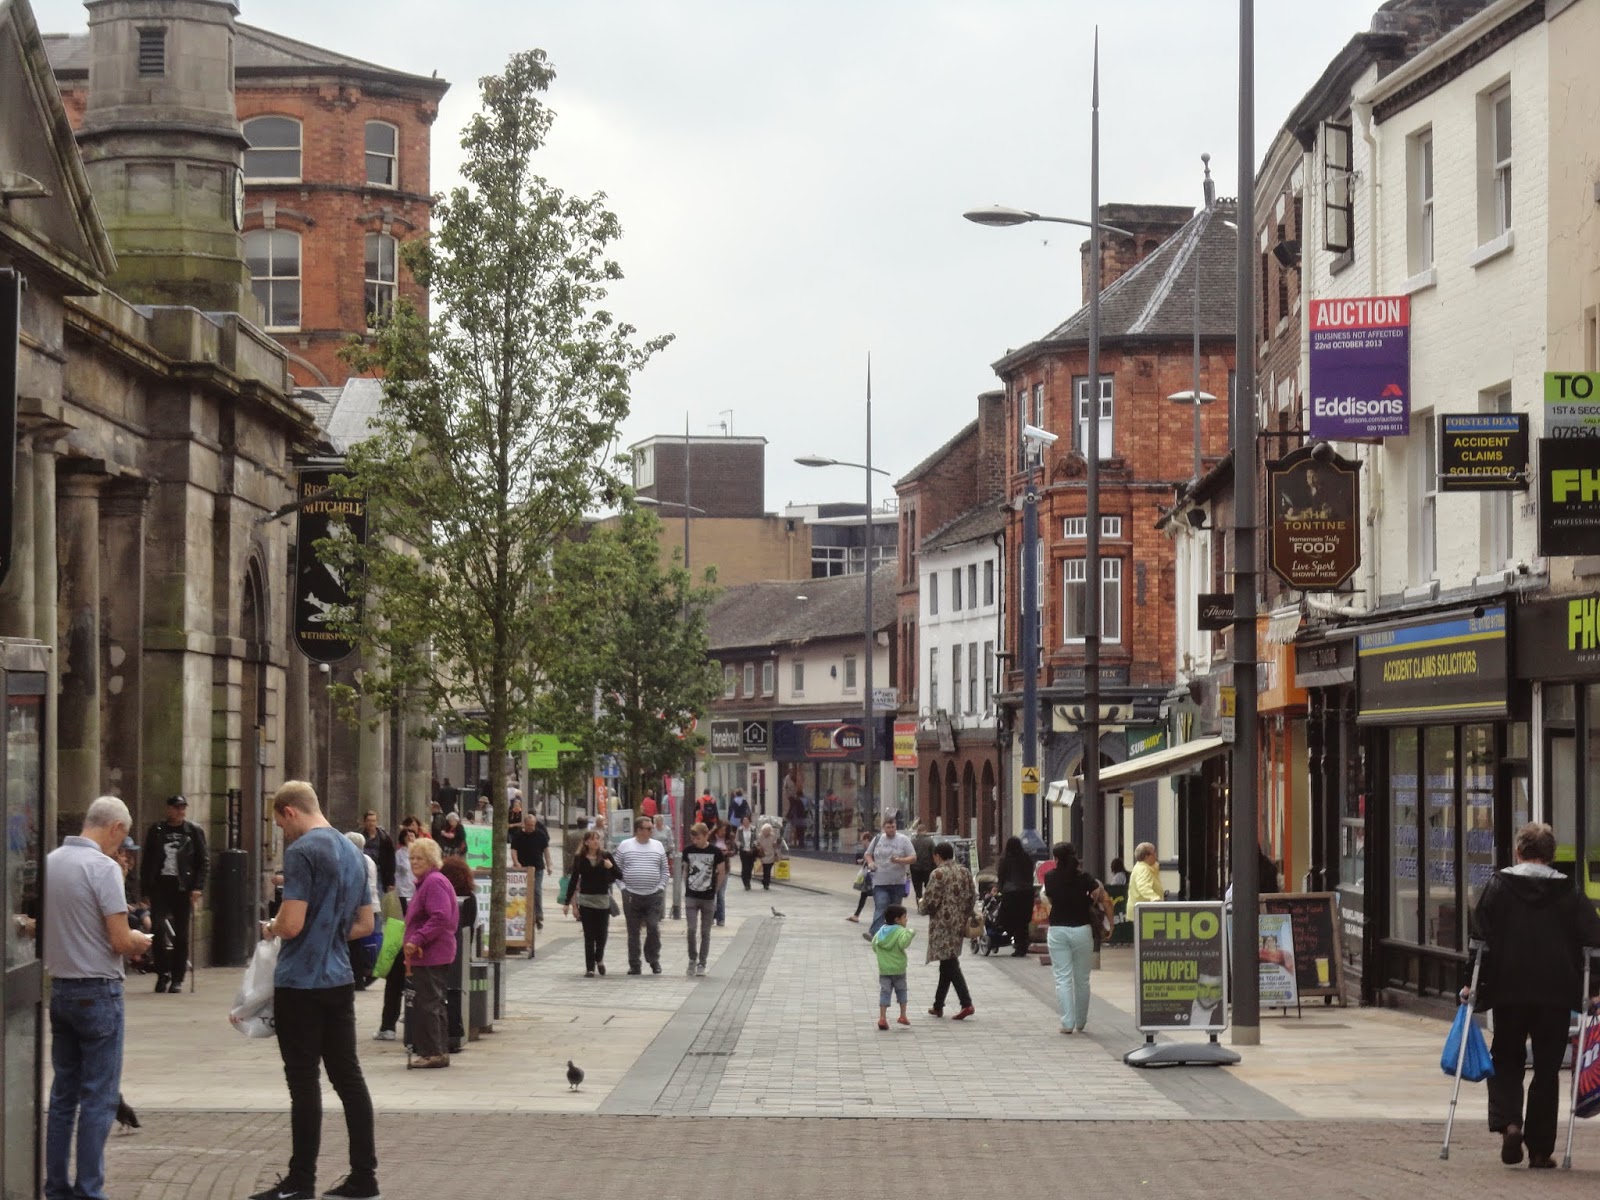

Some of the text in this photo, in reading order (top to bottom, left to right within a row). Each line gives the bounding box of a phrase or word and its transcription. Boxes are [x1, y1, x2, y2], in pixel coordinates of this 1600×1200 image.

[1316, 299, 1400, 326] AUCTION
[1314, 329, 1404, 340] (BUSINESS NOT AFFECTED)
[1314, 339, 1383, 350] 22nd OCTOBER 2013
[1554, 374, 1593, 398] TO
[1314, 396, 1404, 417] Eddisons
[1552, 406, 1568, 415] 1ST
[1569, 406, 1576, 415] &
[1446, 417, 1519, 427] FORSTER DEAN
[1453, 437, 1510, 448] ACCIDENT
[1461, 451, 1504, 461] CLAIMS
[1283, 521, 1346, 531] TONTINE
[1289, 535, 1324, 543] Homemade
[1293, 542, 1336, 554] FOOD
[1291, 559, 1336, 575] Live Sport
[1383, 650, 1477, 682] ACCIDENT CLAIMS SOLICITORS
[843, 737, 861, 747] HILL
[1129, 732, 1163, 757] SUBWAY
[505, 874, 528, 885] RIDAY
[1142, 911, 1219, 940] FHO
[1142, 960, 1198, 980] NOW OPEN
